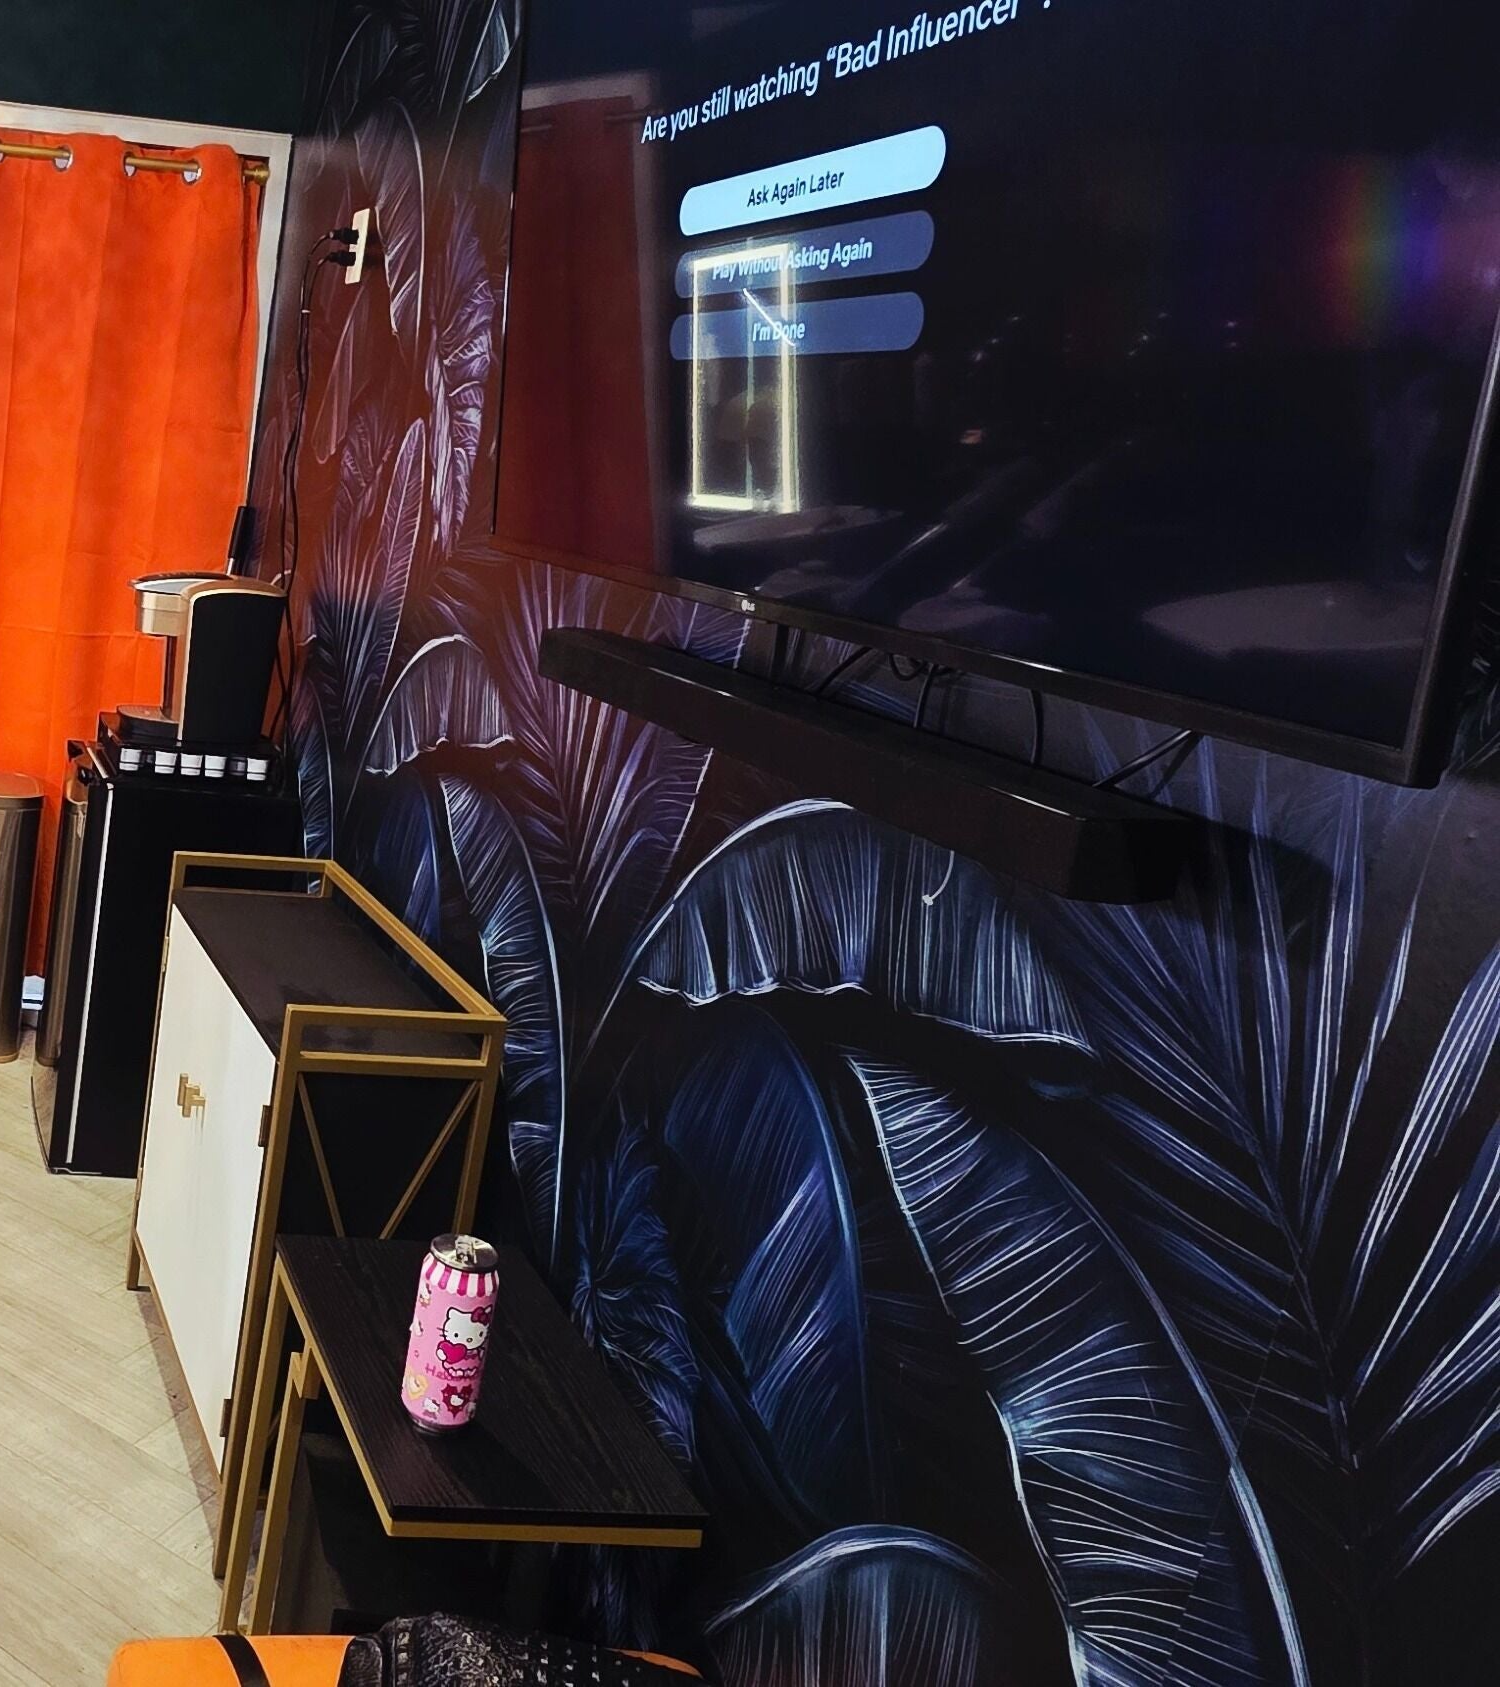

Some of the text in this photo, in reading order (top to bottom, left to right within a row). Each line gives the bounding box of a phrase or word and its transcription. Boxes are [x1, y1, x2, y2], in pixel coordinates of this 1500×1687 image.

[641, 116, 667, 144] Are
[670, 105, 699, 142] you
[701, 85, 731, 123] still
[734, 61, 820, 111] watching
[747, 171, 844, 208] Ask Again Later
[712, 237, 872, 283] Play Without Asking Again
[753, 321, 806, 341] I'm Done
